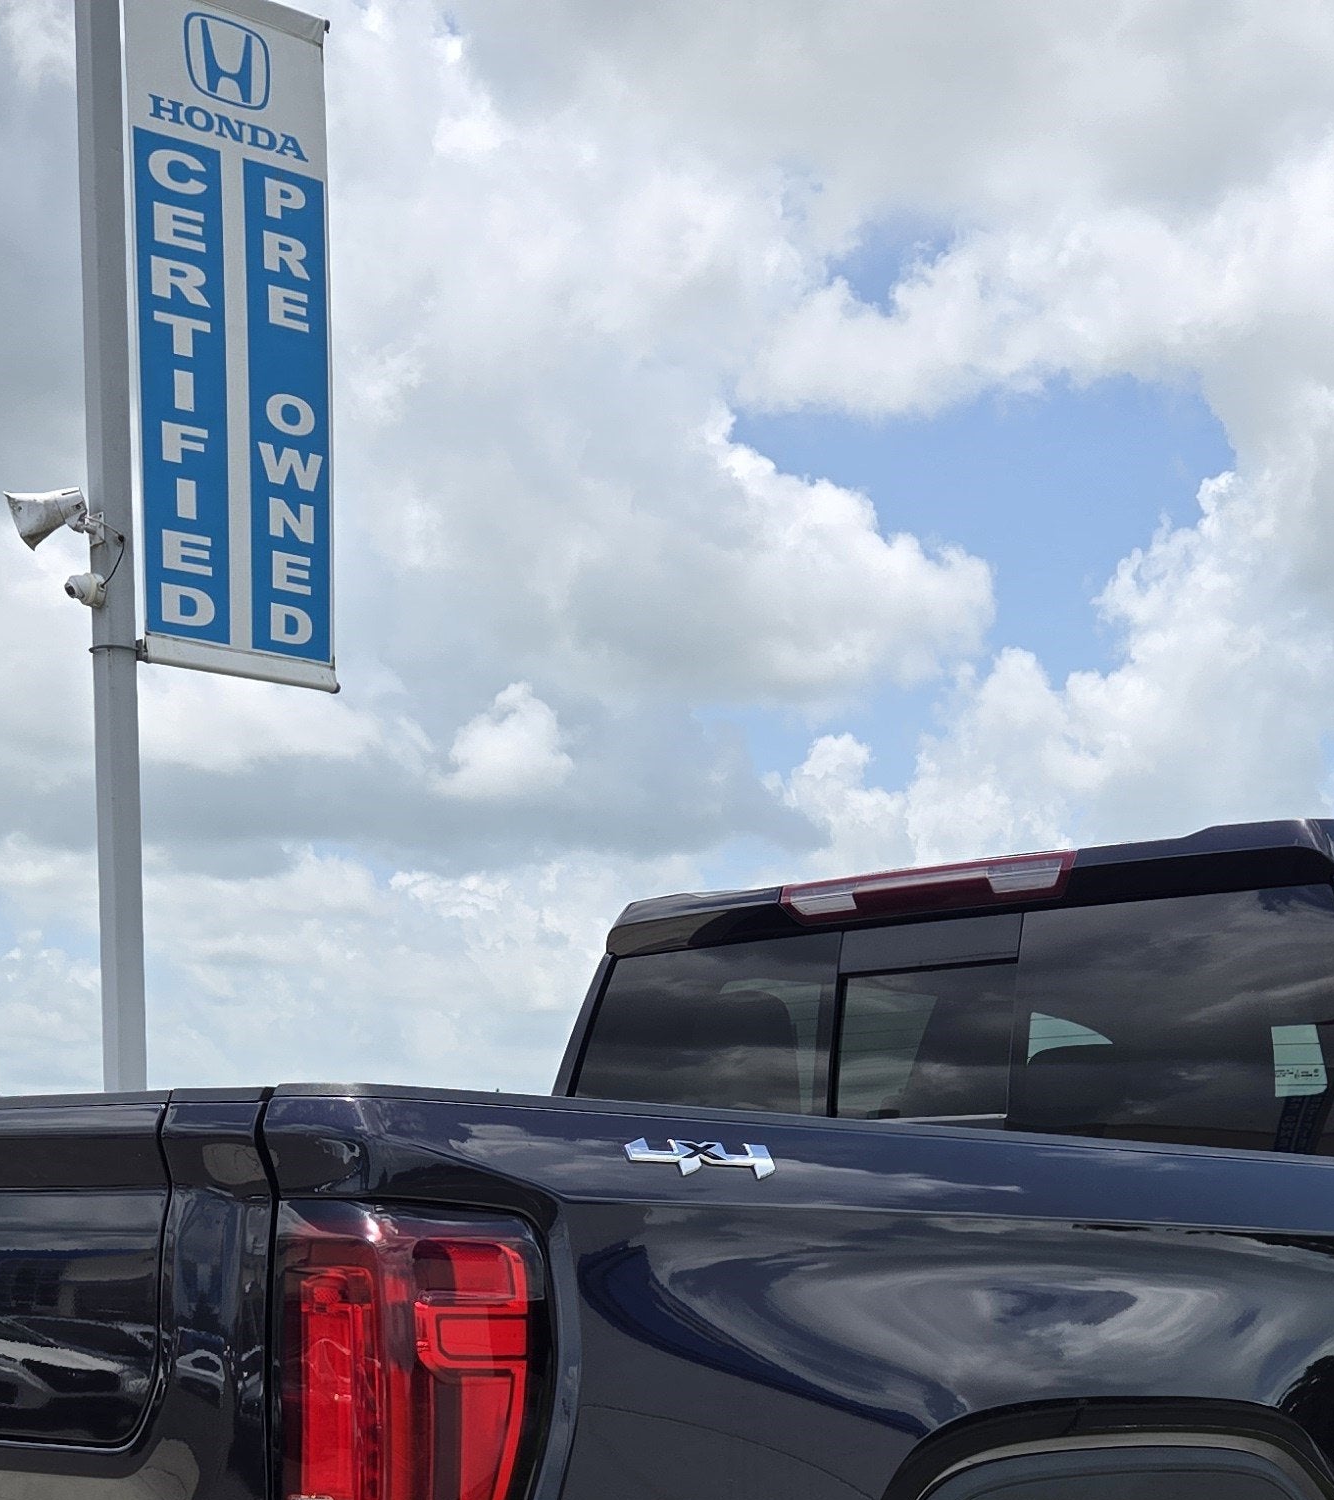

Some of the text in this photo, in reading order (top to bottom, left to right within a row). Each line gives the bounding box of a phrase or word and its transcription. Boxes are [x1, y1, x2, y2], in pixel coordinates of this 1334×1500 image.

[148, 93, 309, 162] HONDA
[148, 149, 215, 627] CERTIFIED
[258, 177, 323, 645] PRE OWNED
